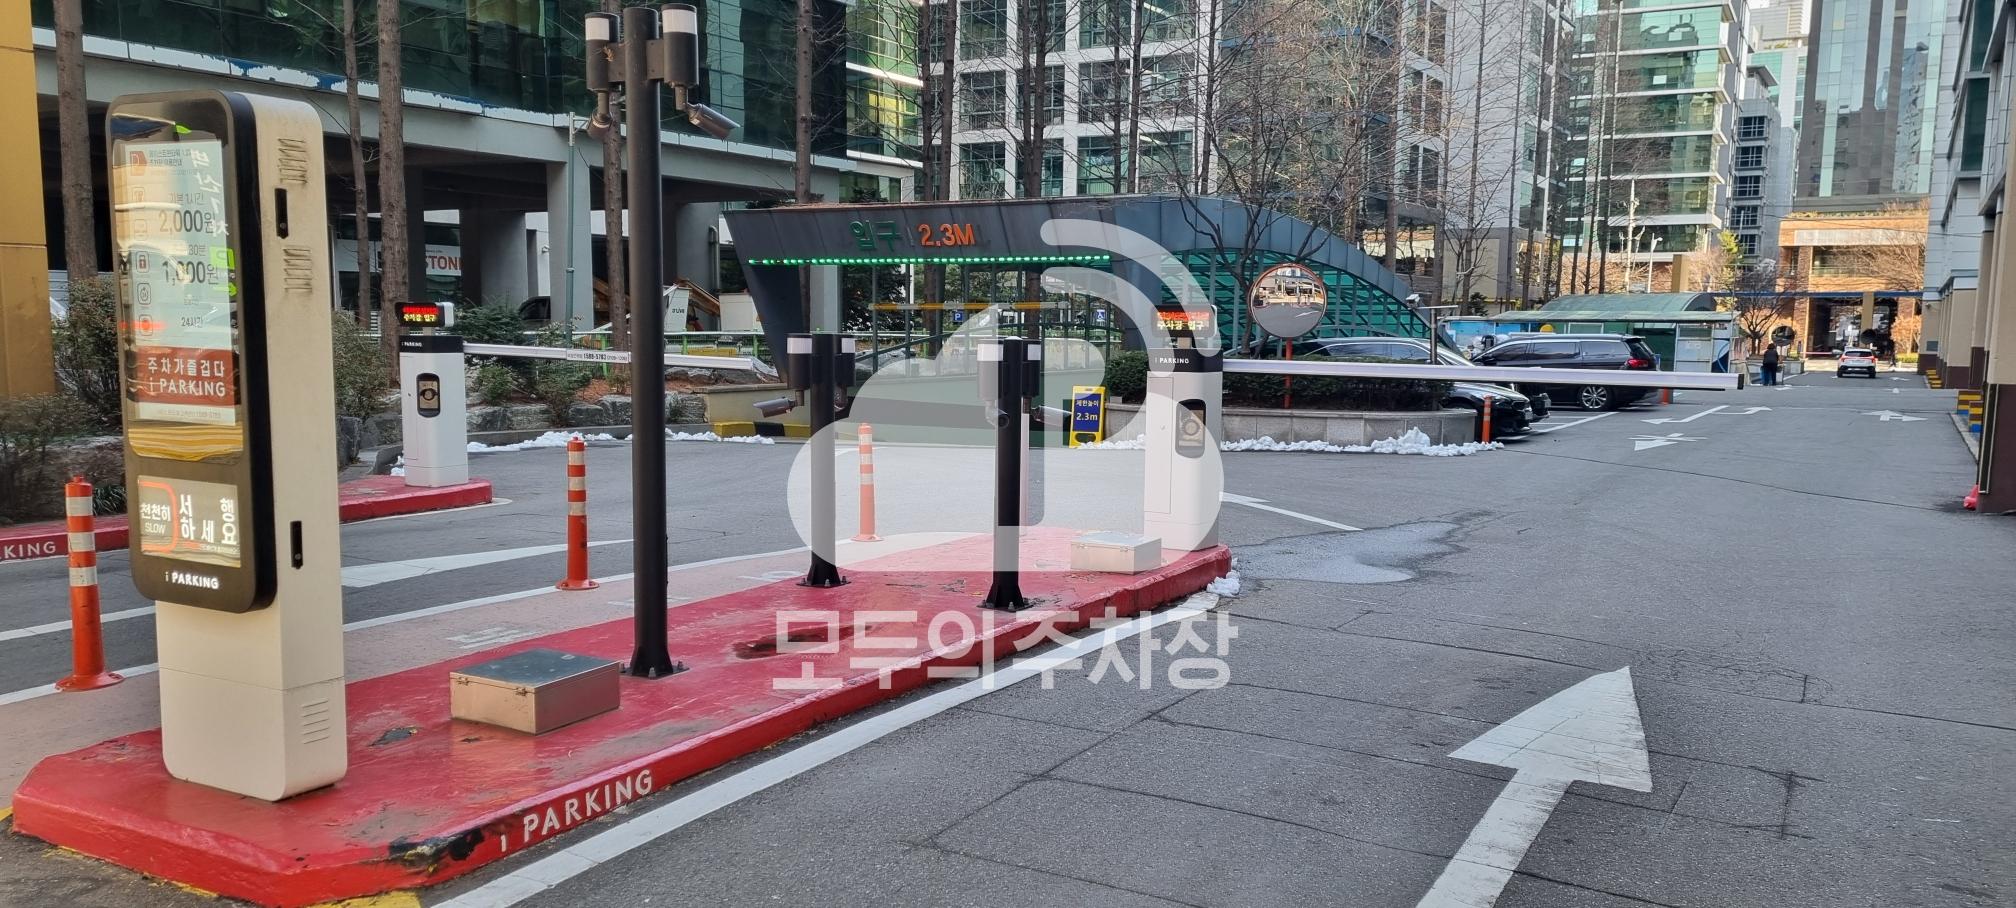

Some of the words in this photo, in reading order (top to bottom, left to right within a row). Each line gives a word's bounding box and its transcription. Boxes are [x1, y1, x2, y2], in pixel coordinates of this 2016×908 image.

[159, 209, 216, 235] 2,000원
[849, 220, 901, 253] 입구
[917, 222, 976, 249] 2.3M
[425, 255, 464, 271] TON
[159, 378, 226, 398] PARKING
[1075, 412, 1099, 421] 2.3m
[140, 501, 172, 522] 천천히
[144, 521, 167, 535] SLOW
[0, 541, 57, 561] KING
[171, 571, 220, 590] PARKING
[523, 769, 653, 843] PARKING
